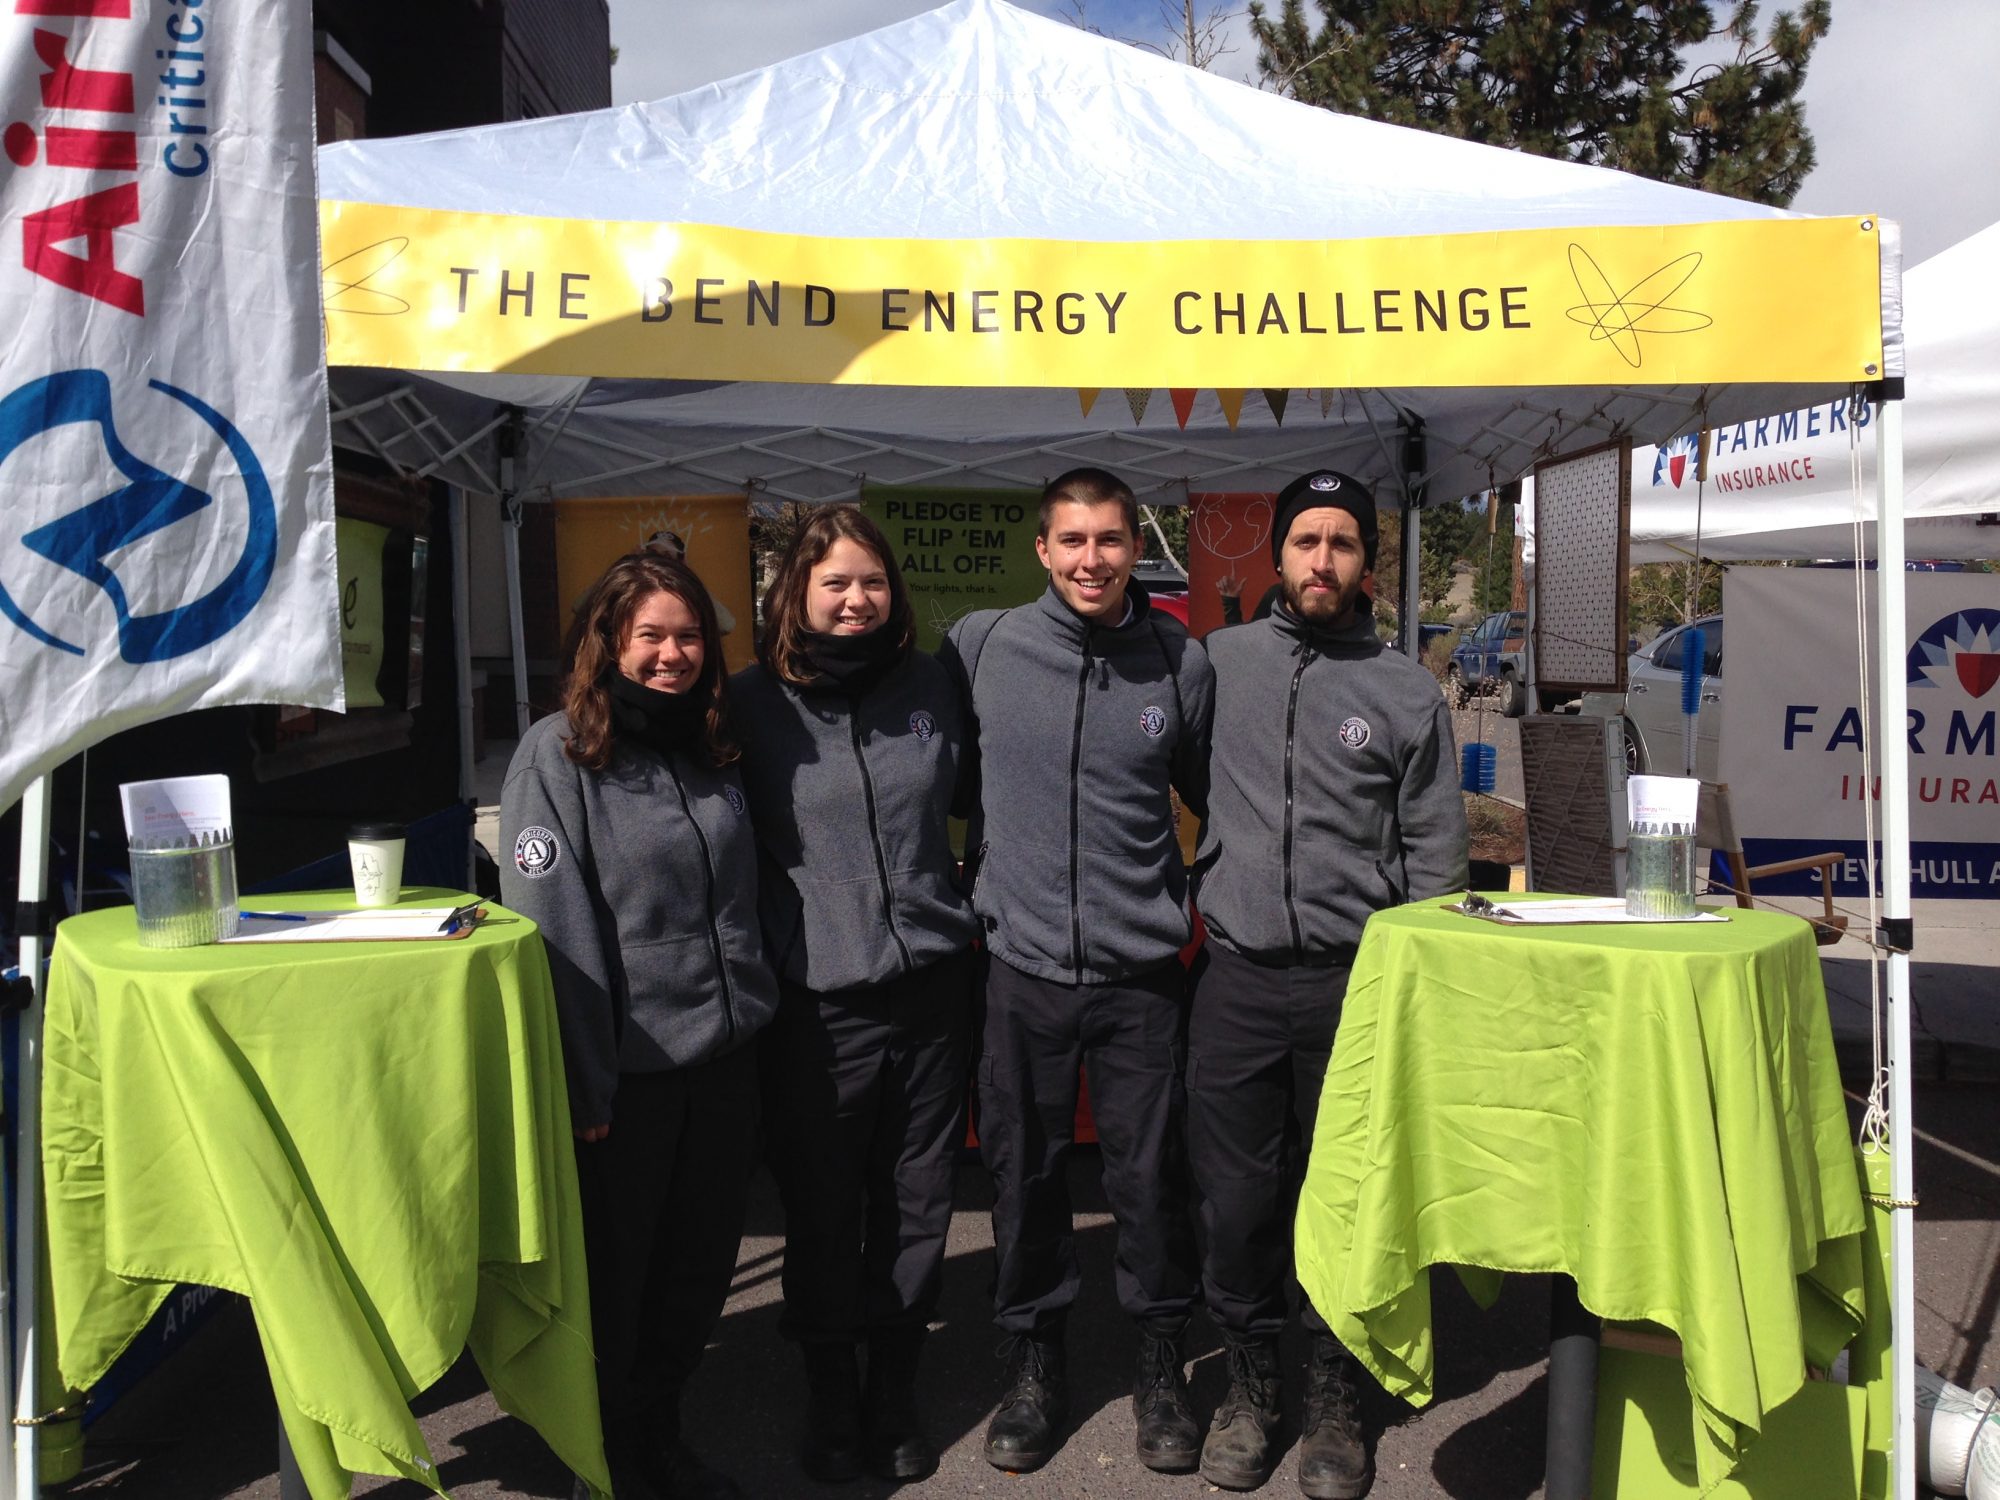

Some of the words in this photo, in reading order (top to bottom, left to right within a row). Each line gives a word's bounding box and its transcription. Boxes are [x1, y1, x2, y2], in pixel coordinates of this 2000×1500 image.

[156, 0, 209, 178] Critic
[450, 267, 590, 320] THE
[641, 277, 836, 327] BEND
[881, 289, 1128, 335] ENERGY
[1173, 287, 1532, 335] CHALLENGE
[1715, 457, 1815, 493] INSURANCE
[886, 501, 982, 523] PLEDGE
[990, 504, 1025, 523] TO
[903, 528, 953, 547] FLIP
[901, 554, 946, 573] ALL
[953, 555, 1006, 574] OFF.
[909, 584, 930, 593] Your
[933, 584, 962, 594] lights,
[966, 585, 985, 594] that
[988, 585, 998, 594] is.
[1841, 775, 2000, 804] INURA
[527, 841, 545, 861] A
[1909, 859, 1980, 884] HULL
